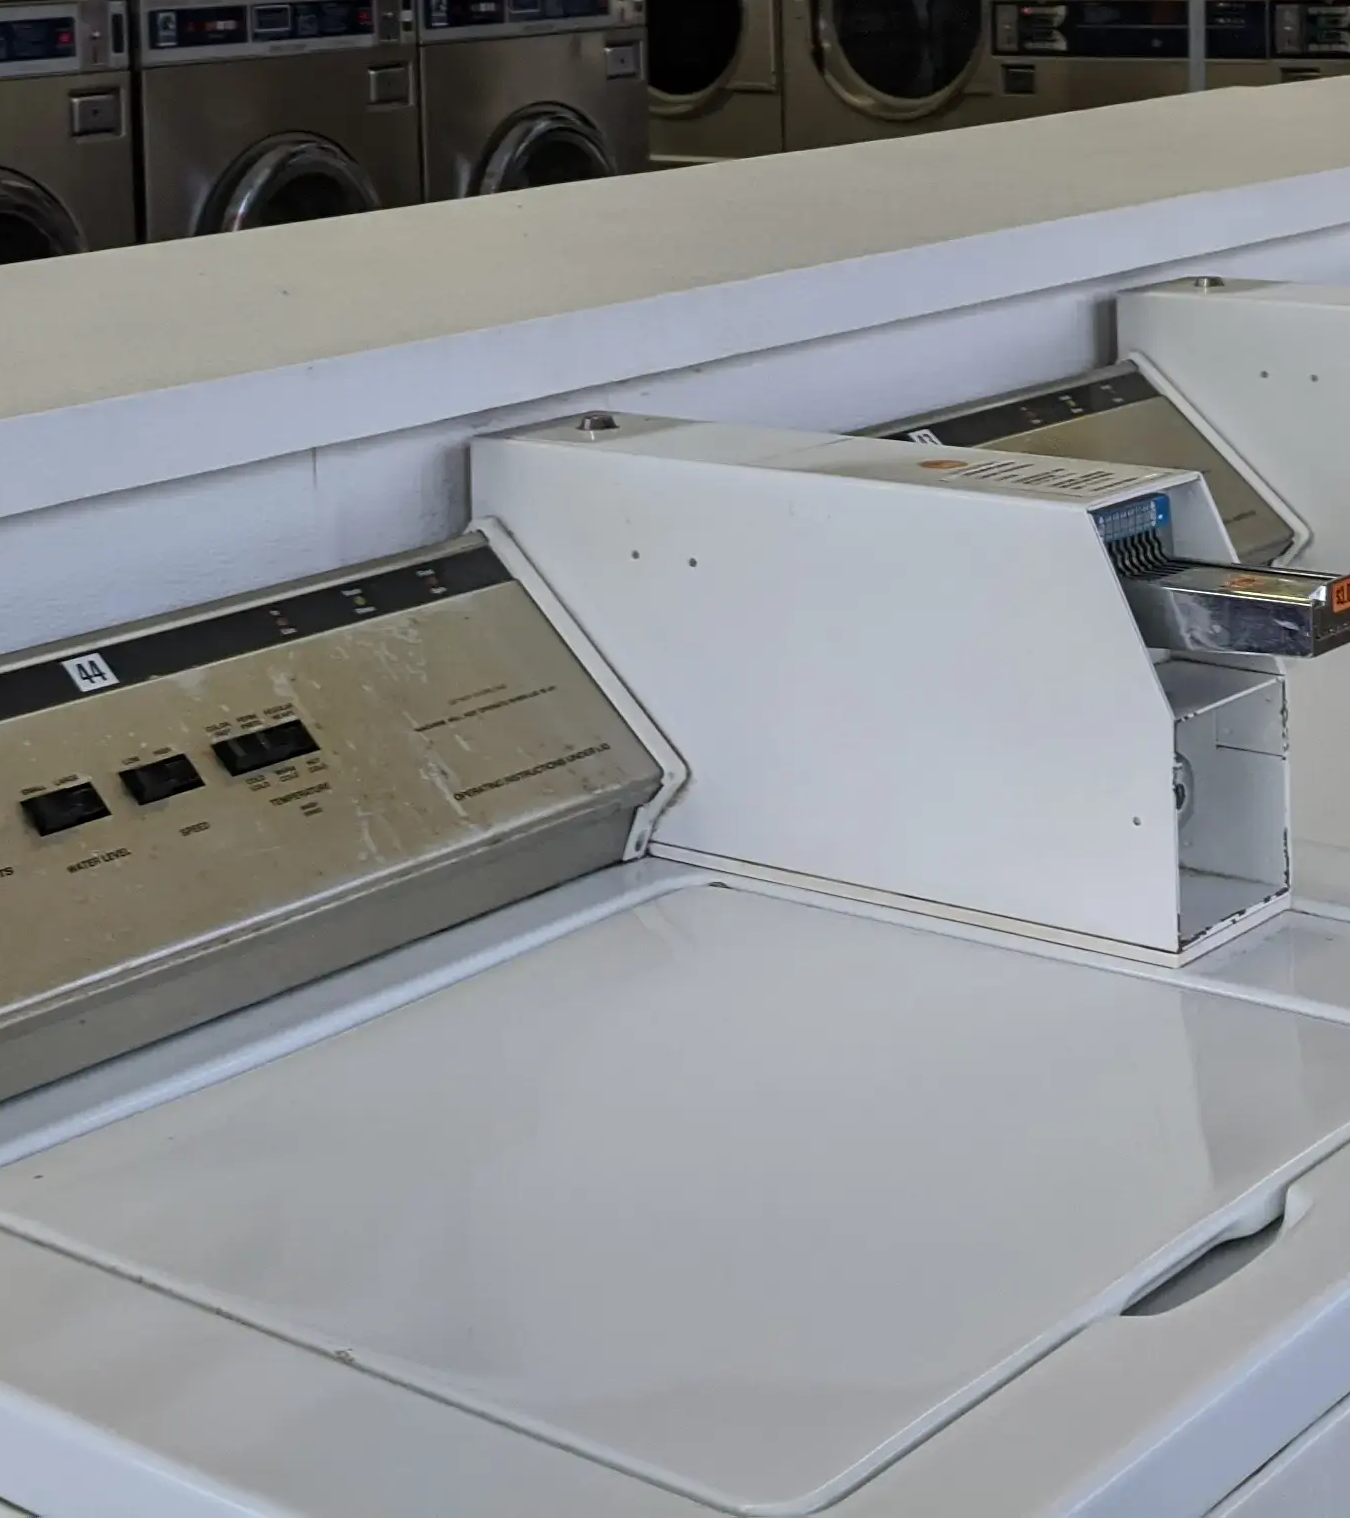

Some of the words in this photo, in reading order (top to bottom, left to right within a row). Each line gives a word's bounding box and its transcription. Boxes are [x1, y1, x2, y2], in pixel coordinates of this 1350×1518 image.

[76, 660, 108, 684] 44
[453, 778, 502, 802] OPERATING
[502, 757, 567, 782] INSTRUCTIONS
[566, 746, 597, 763] UNDER
[269, 782, 331, 807] TEMPERATURE
[179, 821, 211, 837] SPEED
[66, 857, 101, 874] WATER
[100, 847, 132, 863] LEVEL
